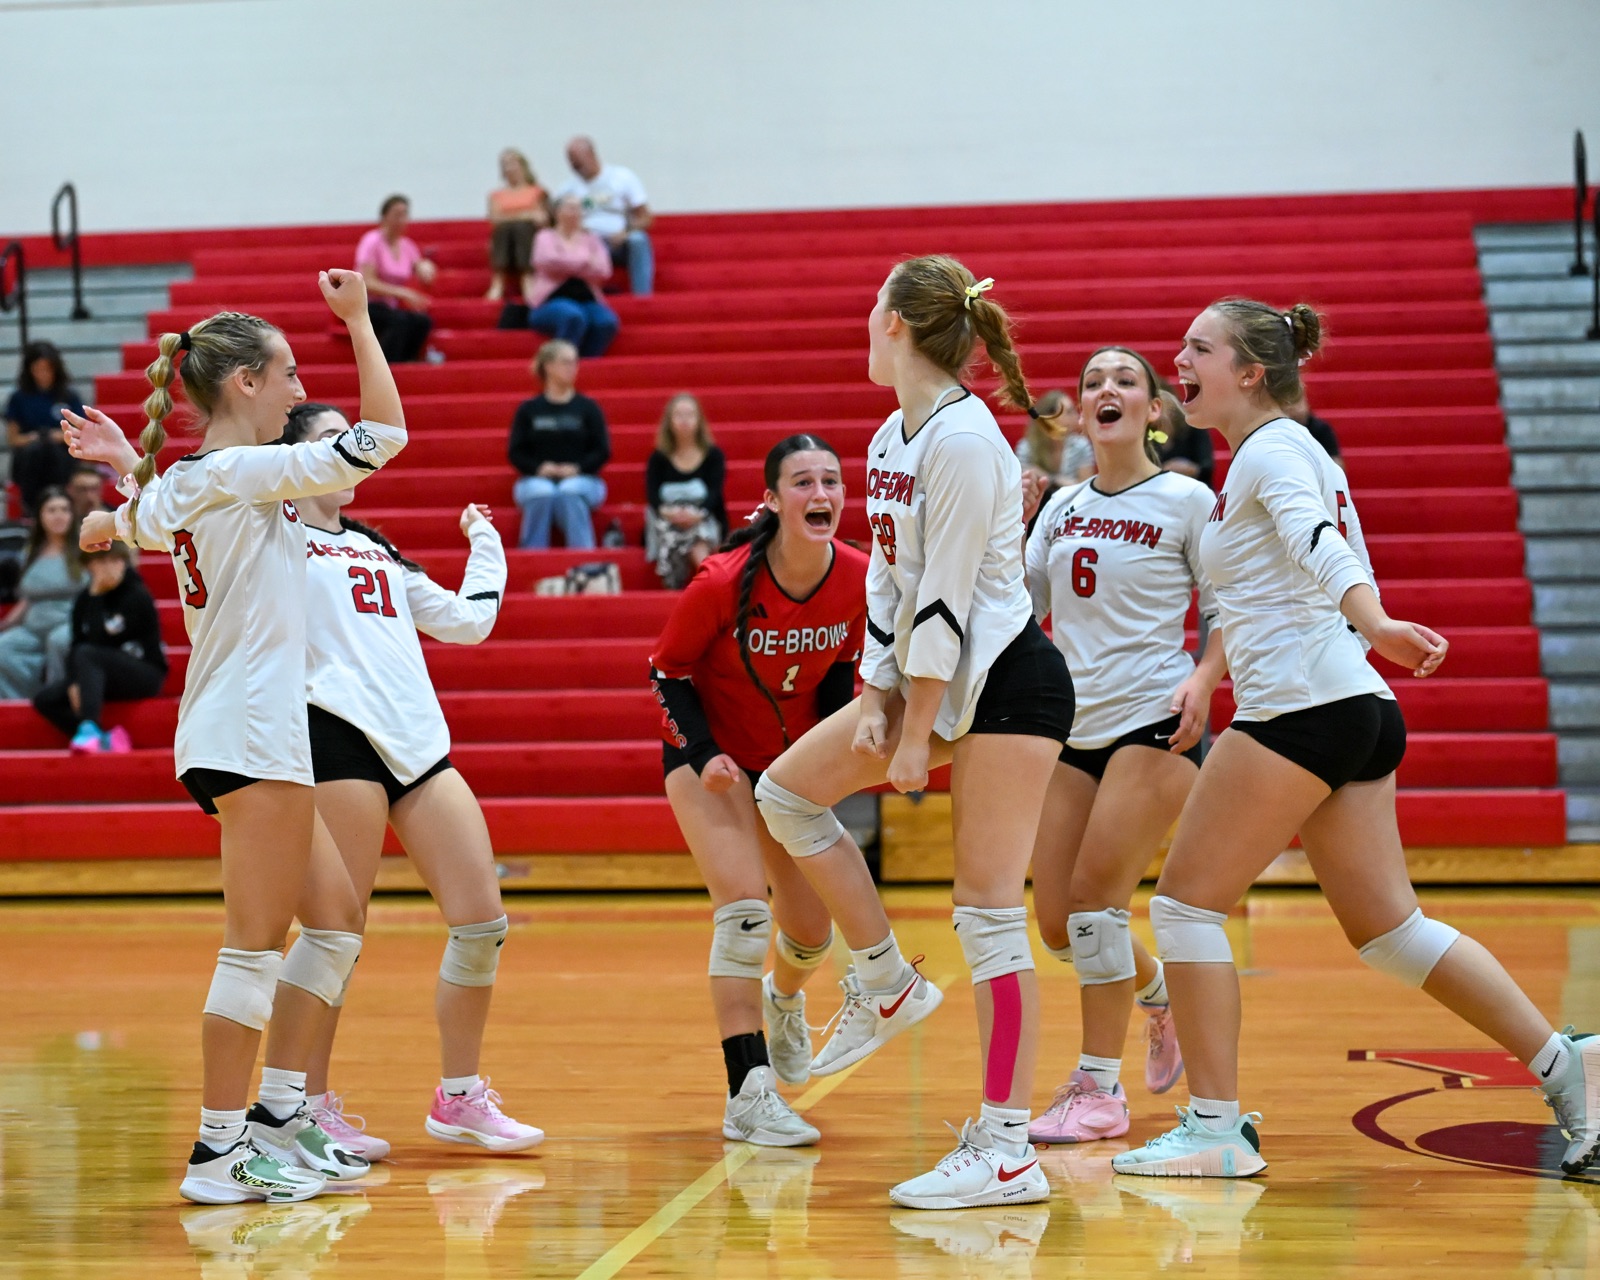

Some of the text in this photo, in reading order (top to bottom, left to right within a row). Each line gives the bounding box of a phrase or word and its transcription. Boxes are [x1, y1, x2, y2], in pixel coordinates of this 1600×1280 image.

[1053, 516, 1163, 549] OE-BROWN
[348, 565, 397, 617] 21
[1072, 547, 1098, 598] 6
[782, 664, 800, 691] 1
